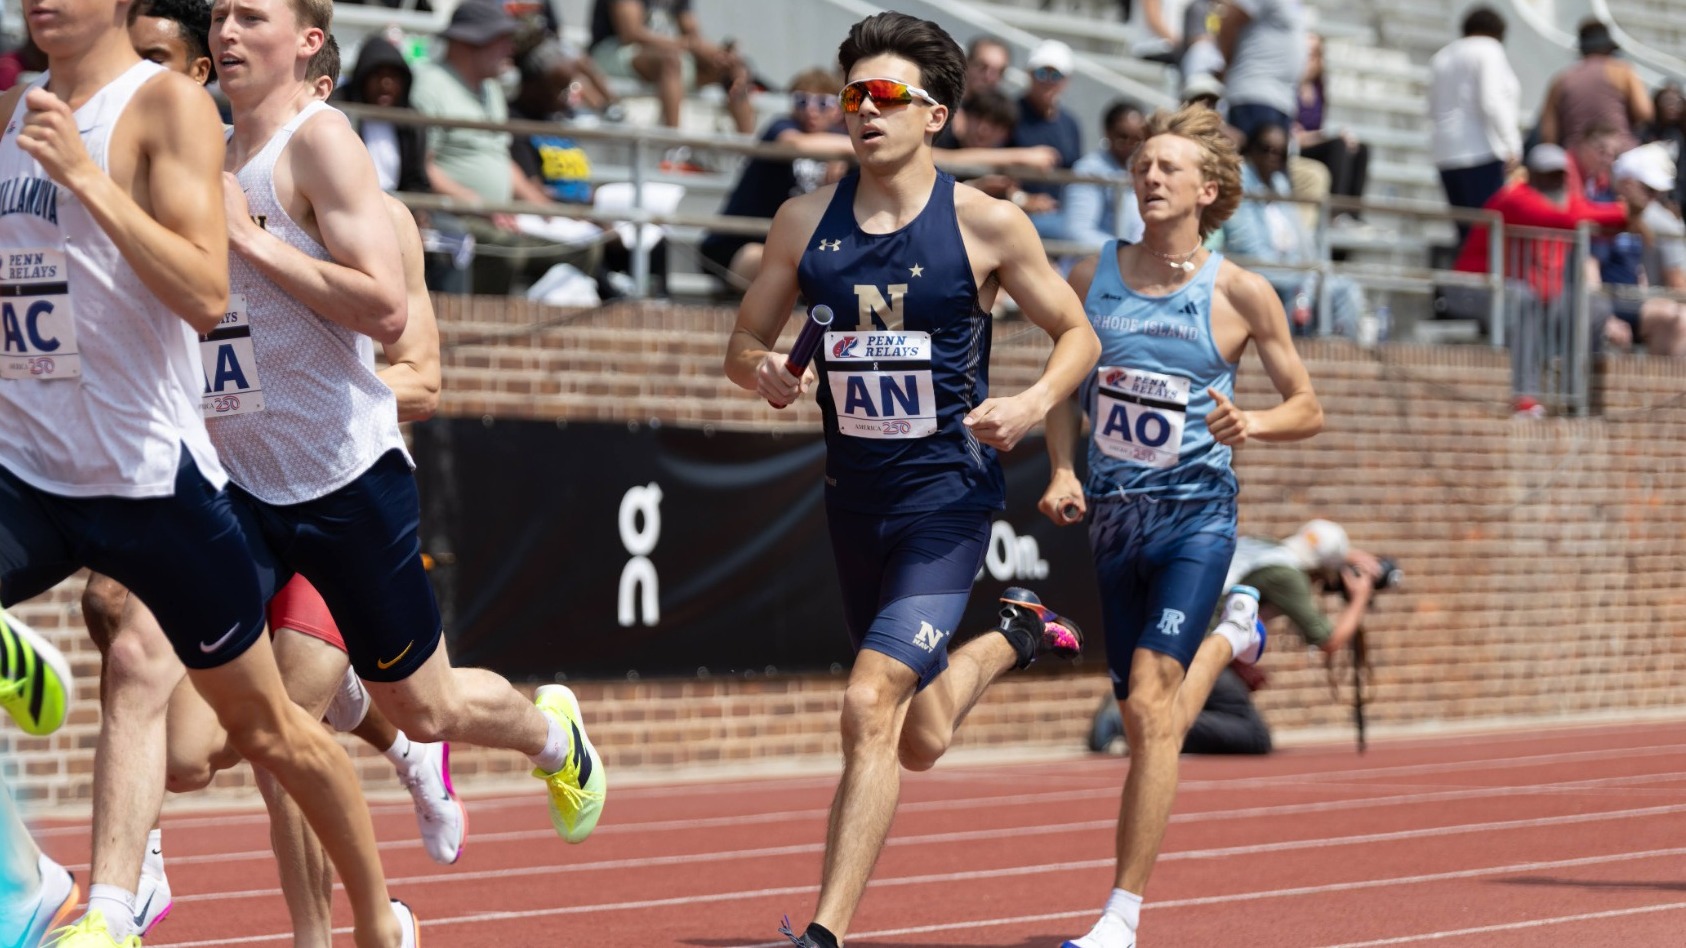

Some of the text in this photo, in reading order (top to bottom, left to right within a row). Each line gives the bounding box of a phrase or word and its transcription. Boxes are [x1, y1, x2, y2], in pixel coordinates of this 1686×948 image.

[0, 177, 58, 226] ILLANOVA
[9, 253, 44, 266] PENN
[9, 265, 57, 280] RELAYS
[854, 283, 908, 331] N
[2, 300, 61, 353] AC
[1093, 315, 1199, 342] RHODE ISLAND
[866, 336, 907, 346] PENN
[864, 346, 919, 357] RELAYS
[203, 343, 250, 393] A
[1135, 376, 1168, 387] PENN
[844, 375, 920, 417] AN
[1132, 383, 1178, 400] RELAYS
[214, 395, 241, 412] 250
[855, 421, 911, 435] AMERICA 250
[1103, 403, 1170, 447] AO
[914, 620, 944, 649] N
[912, 637, 934, 653] NAVY
